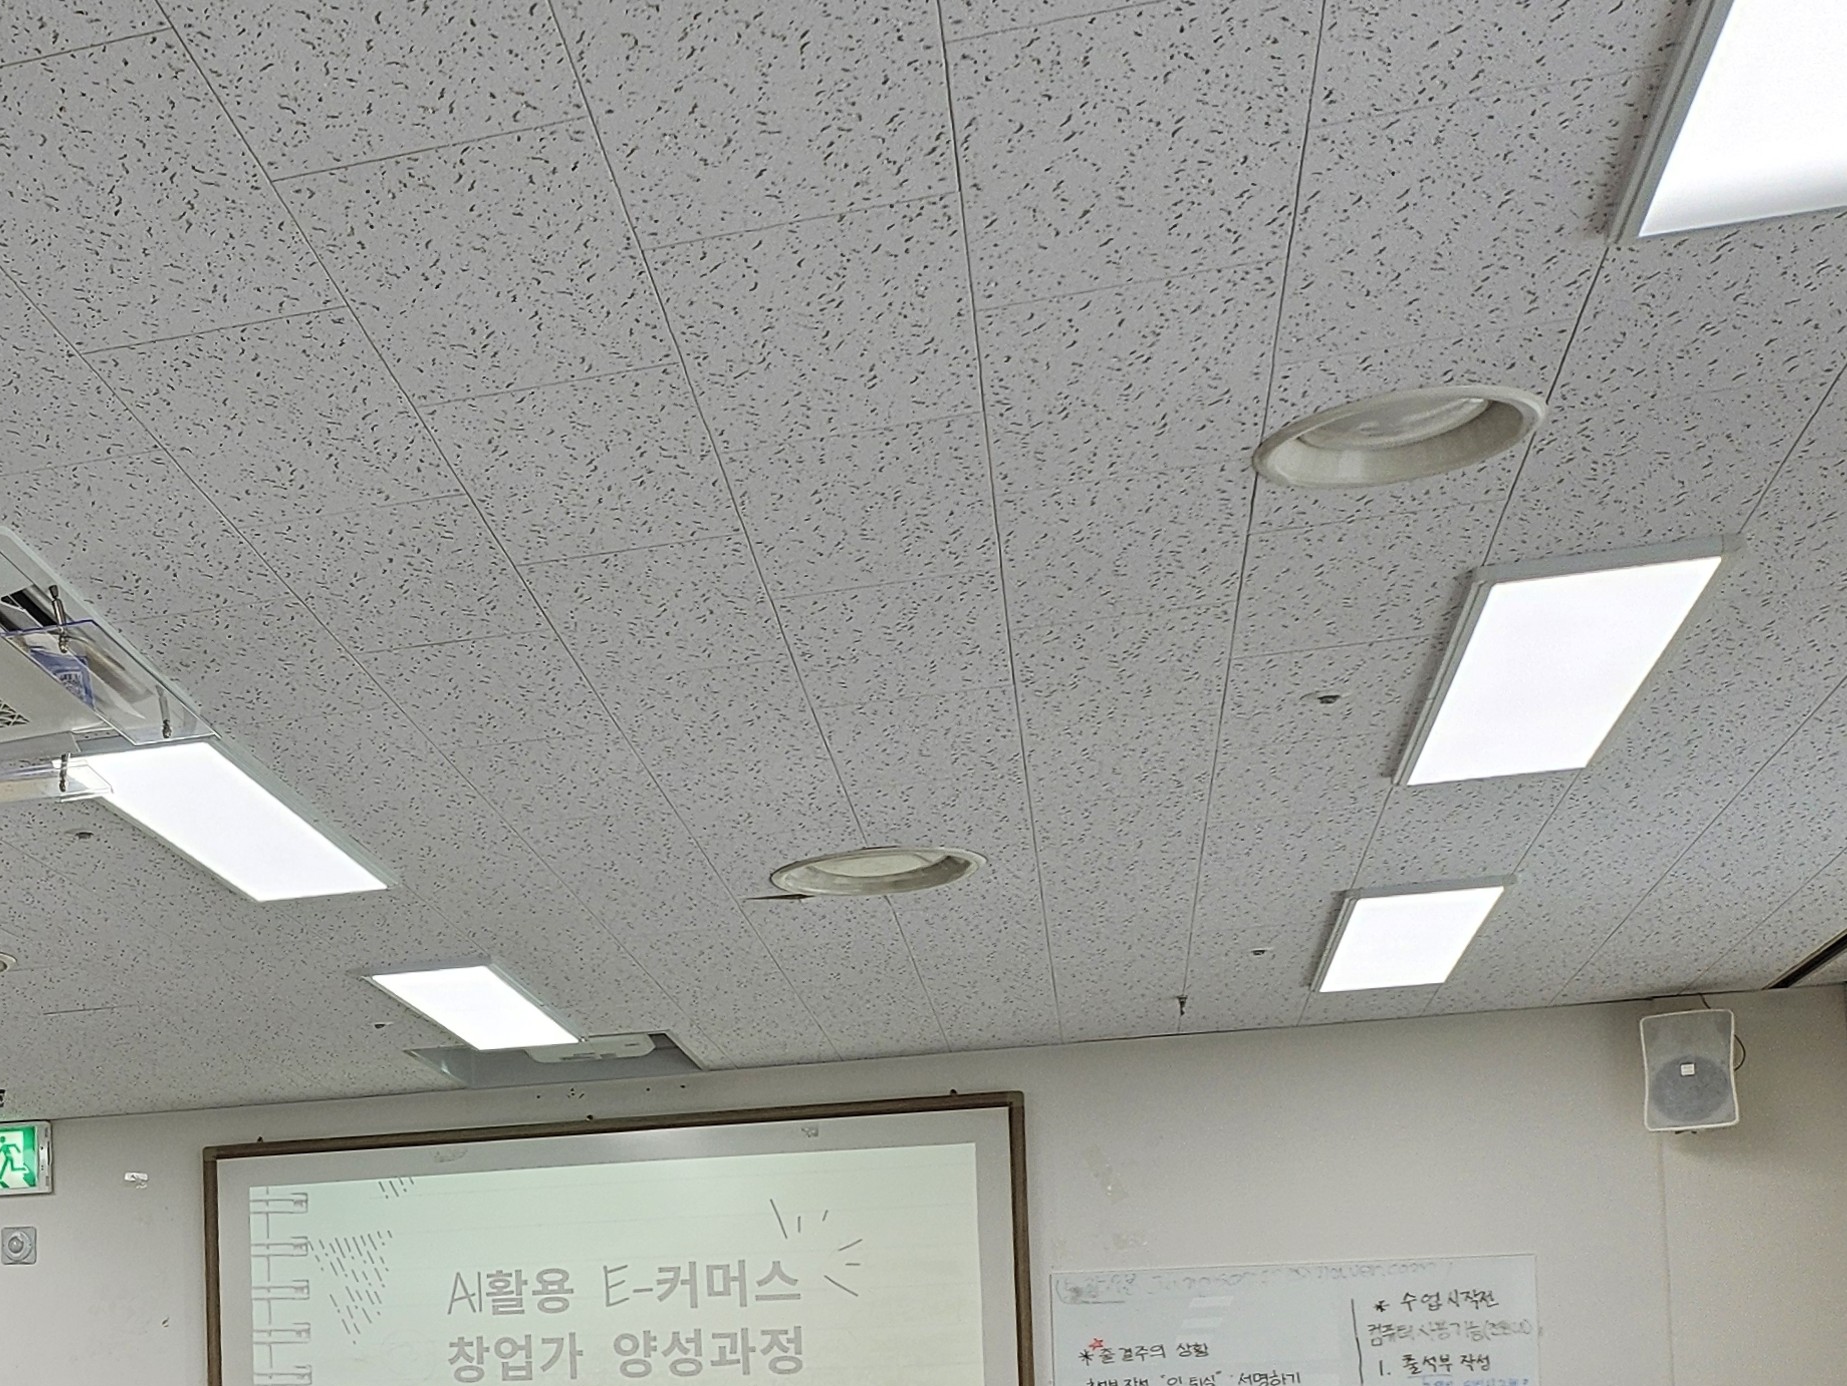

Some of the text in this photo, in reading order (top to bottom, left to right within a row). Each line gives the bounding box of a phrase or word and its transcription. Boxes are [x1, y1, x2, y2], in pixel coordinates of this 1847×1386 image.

[447, 1258, 802, 1316] AI활용 E-커머스
[1401, 1291, 1443, 1312] 수업
[447, 1325, 805, 1384] 창업가 양성과정
[1402, 1354, 1453, 1375] 출석부
[1460, 1353, 1491, 1372] 작성
